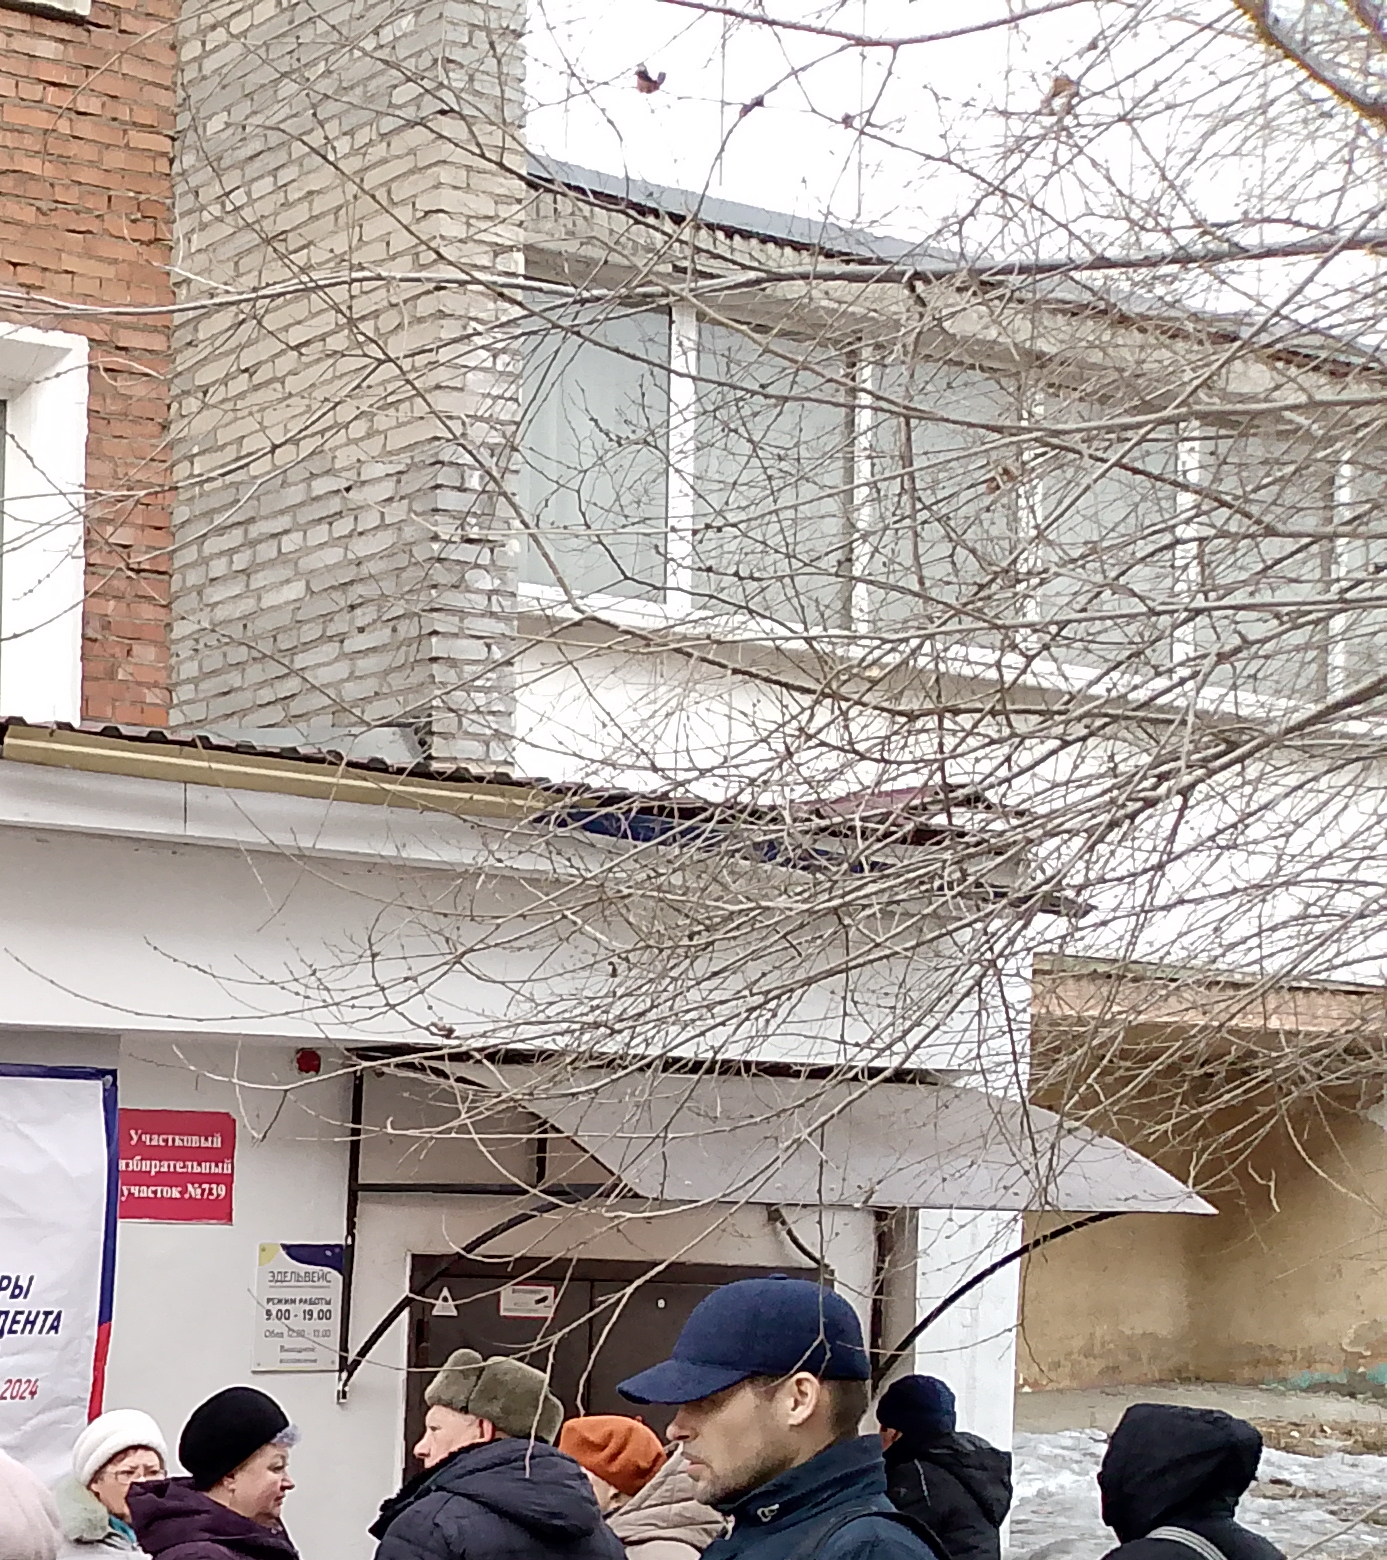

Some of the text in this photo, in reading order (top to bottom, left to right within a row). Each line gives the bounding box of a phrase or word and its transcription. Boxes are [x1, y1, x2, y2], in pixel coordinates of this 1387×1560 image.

[129, 1129, 222, 1148] Участковый
[118, 1155, 232, 1177] избирательный
[120, 1182, 226, 1202] участок №739
[267, 1269, 332, 1284] ЭДЕЛЬВЕЙС
[298, 1297, 332, 1306] РАБОТЫ
[265, 1308, 291, 1321] 9.00
[302, 1308, 332, 1321] 19.00
[0, 1378, 39, 1401] 2024
